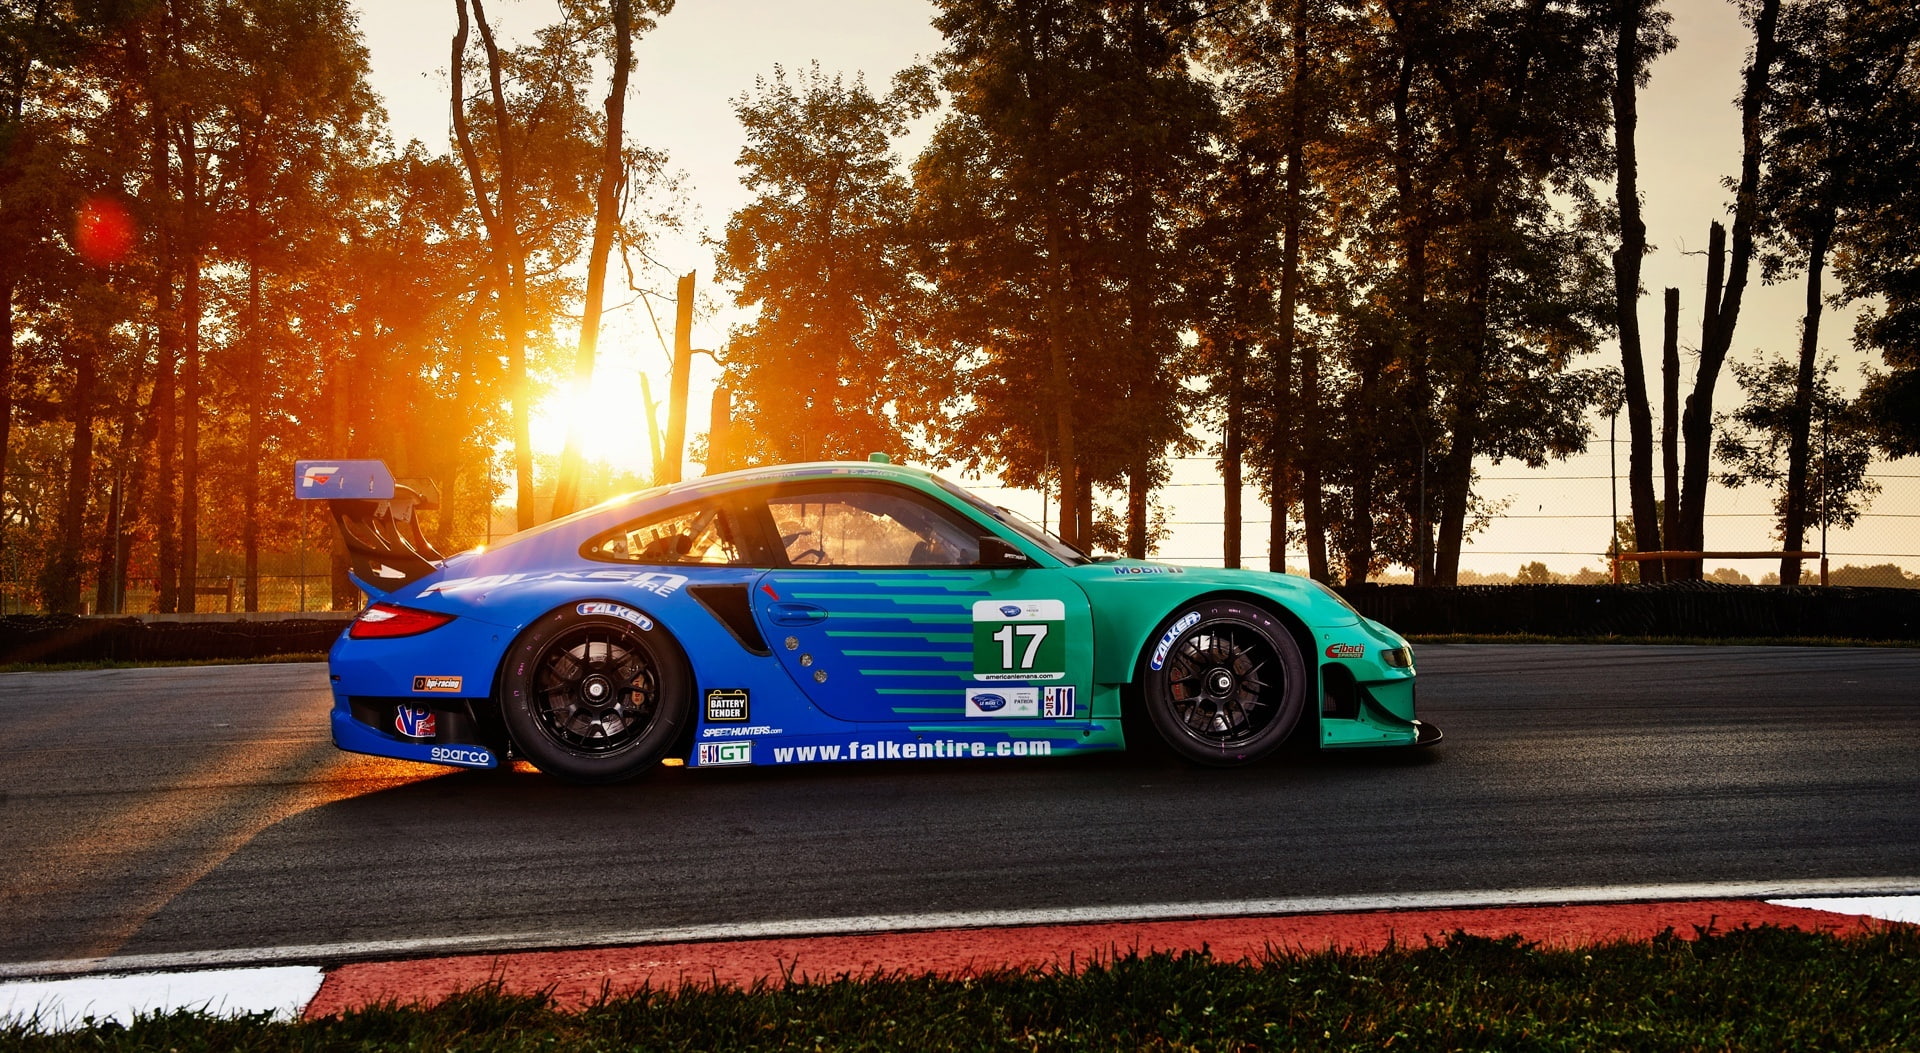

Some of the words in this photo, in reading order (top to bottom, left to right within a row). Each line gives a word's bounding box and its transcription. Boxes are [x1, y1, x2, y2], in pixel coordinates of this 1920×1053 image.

[582, 602, 651, 630] FALKEN
[993, 624, 1048, 669] 17
[1153, 611, 1200, 665] FALKEN
[427, 678, 460, 689] hpi-racing
[711, 700, 744, 708] BATTERY
[1045, 688, 1054, 716] IMSA
[398, 702, 430, 736] VP
[711, 709, 740, 717] TENDER
[703, 726, 782, 737] SPEEDHUNTERS.com
[431, 747, 489, 765] sparco
[721, 745, 748, 760] GT
[774, 740, 1051, 762] www.falkentire.com
